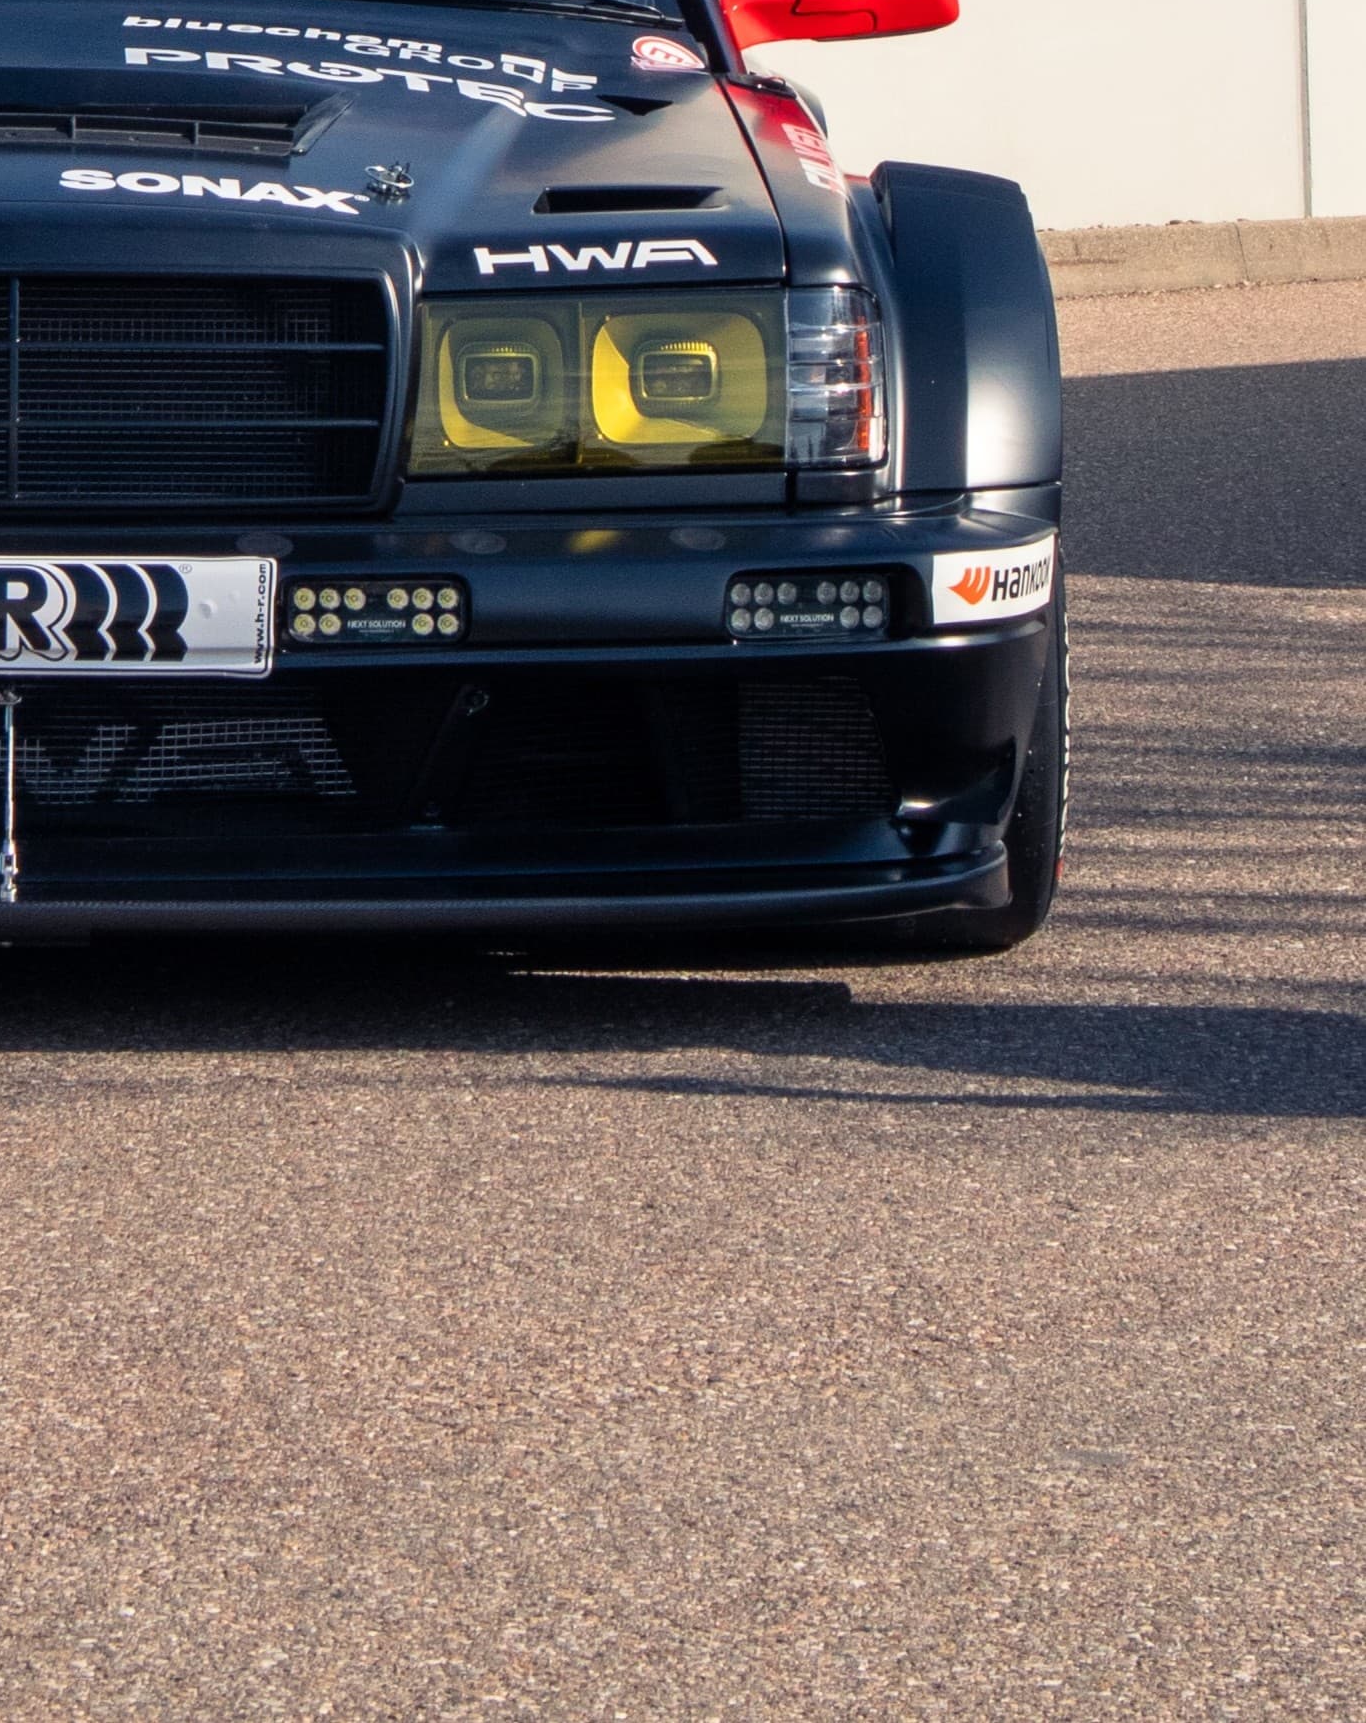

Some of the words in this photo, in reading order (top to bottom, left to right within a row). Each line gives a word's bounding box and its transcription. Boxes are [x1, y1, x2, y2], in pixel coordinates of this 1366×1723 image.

[122, 16, 443, 53] bluechem
[124, 48, 616, 122] PROTEC
[344, 43, 598, 93] GROUP
[474, 238, 718, 275] HWA
[254, 563, 267, 664] www.h-r.com
[347, 620, 367, 628] NEXT
[780, 614, 798, 623] NEXT
[799, 613, 834, 622] SOLUTION
